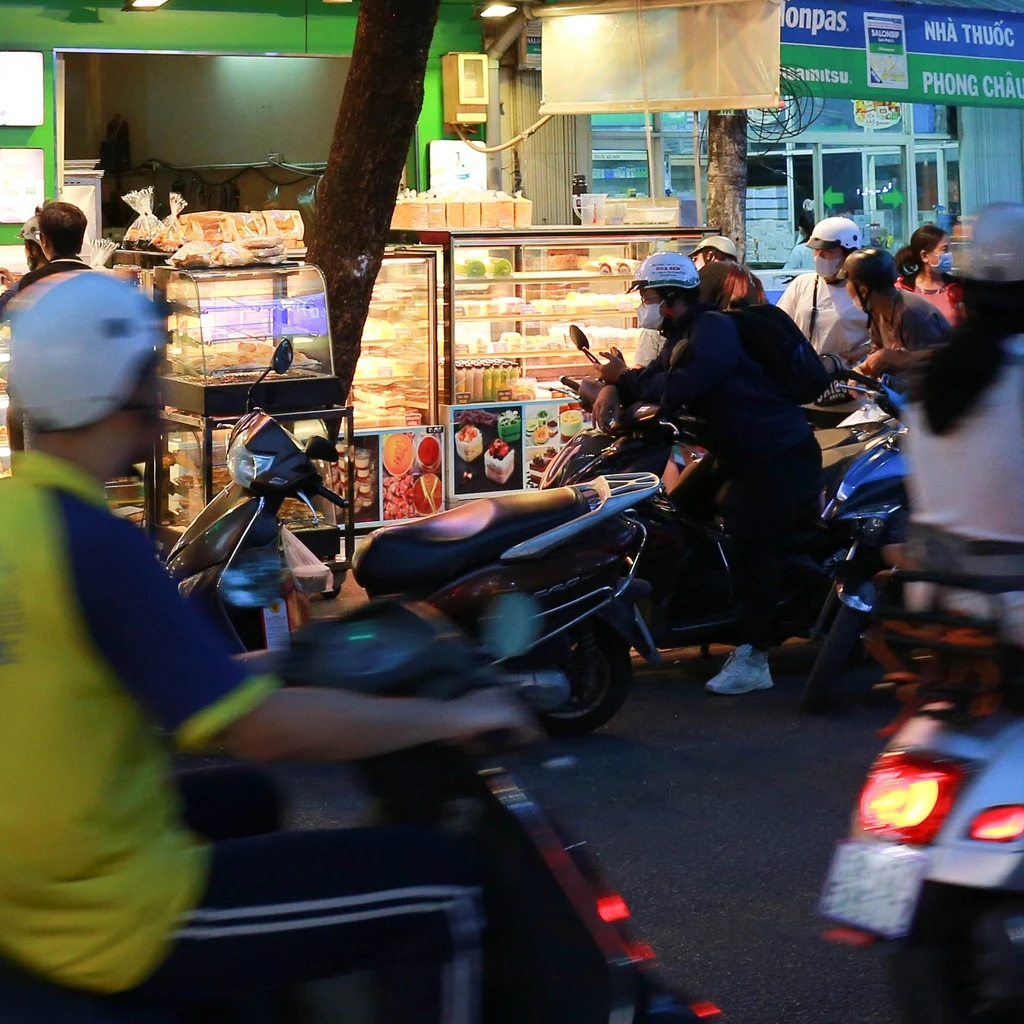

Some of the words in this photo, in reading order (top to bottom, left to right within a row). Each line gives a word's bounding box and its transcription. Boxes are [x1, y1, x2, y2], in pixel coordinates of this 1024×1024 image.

[924, 17, 958, 43] NHÀ
[961, 20, 1015, 48] THUỐC
[922, 71, 980, 97] PHONG
[982, 71, 1024, 99] CHÂU
